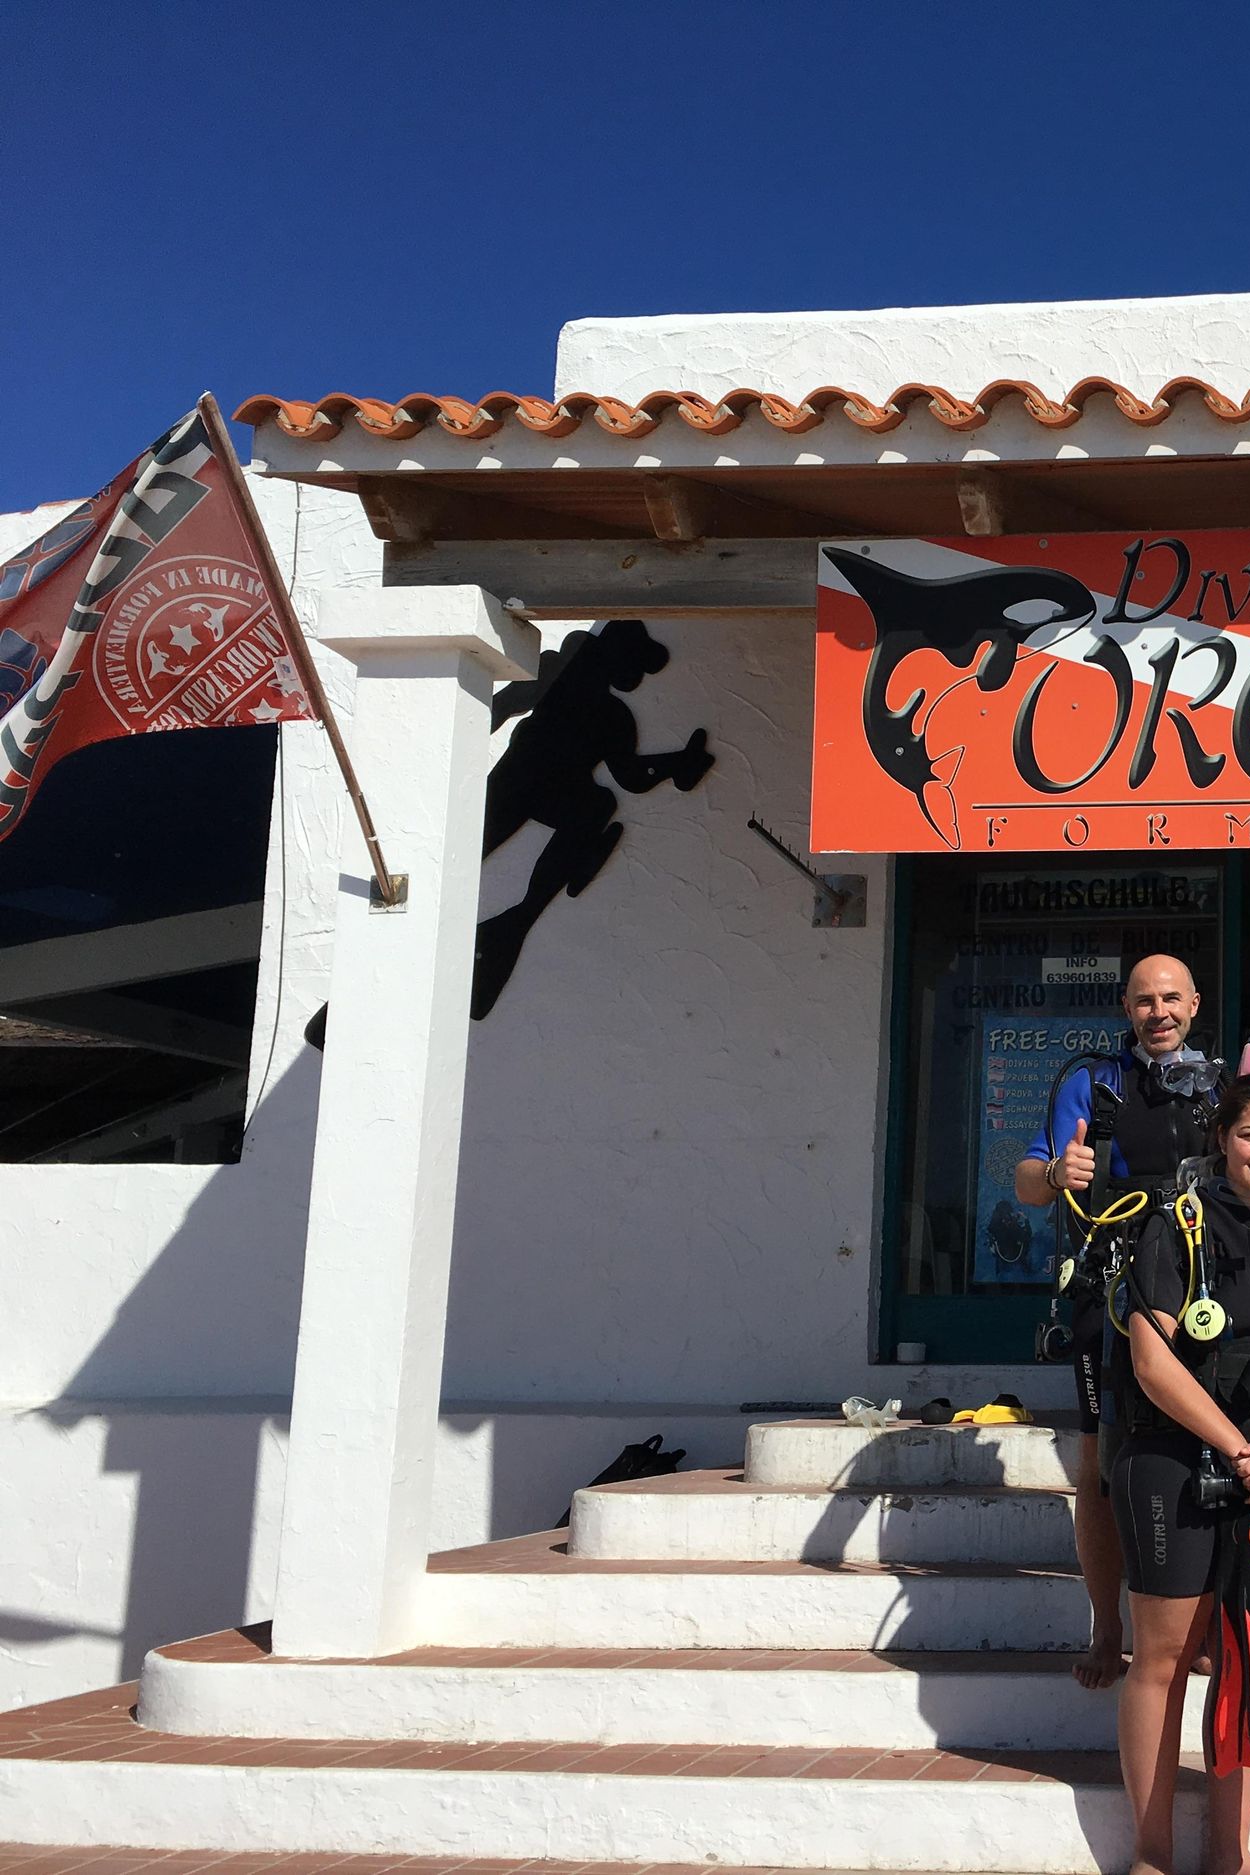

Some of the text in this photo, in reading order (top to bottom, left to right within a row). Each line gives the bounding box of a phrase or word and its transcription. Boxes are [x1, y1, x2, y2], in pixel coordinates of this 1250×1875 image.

[1066, 957, 1098, 968] INFO
[1046, 971, 1117, 984] 639601839
[989, 1029, 1127, 1051] FREE-GRAT
[1008, 1060, 1039, 1069] DIVING
[1082, 1353, 1100, 1415] COLTRI SUB
[1151, 1494, 1168, 1566] COLTRI SUB
